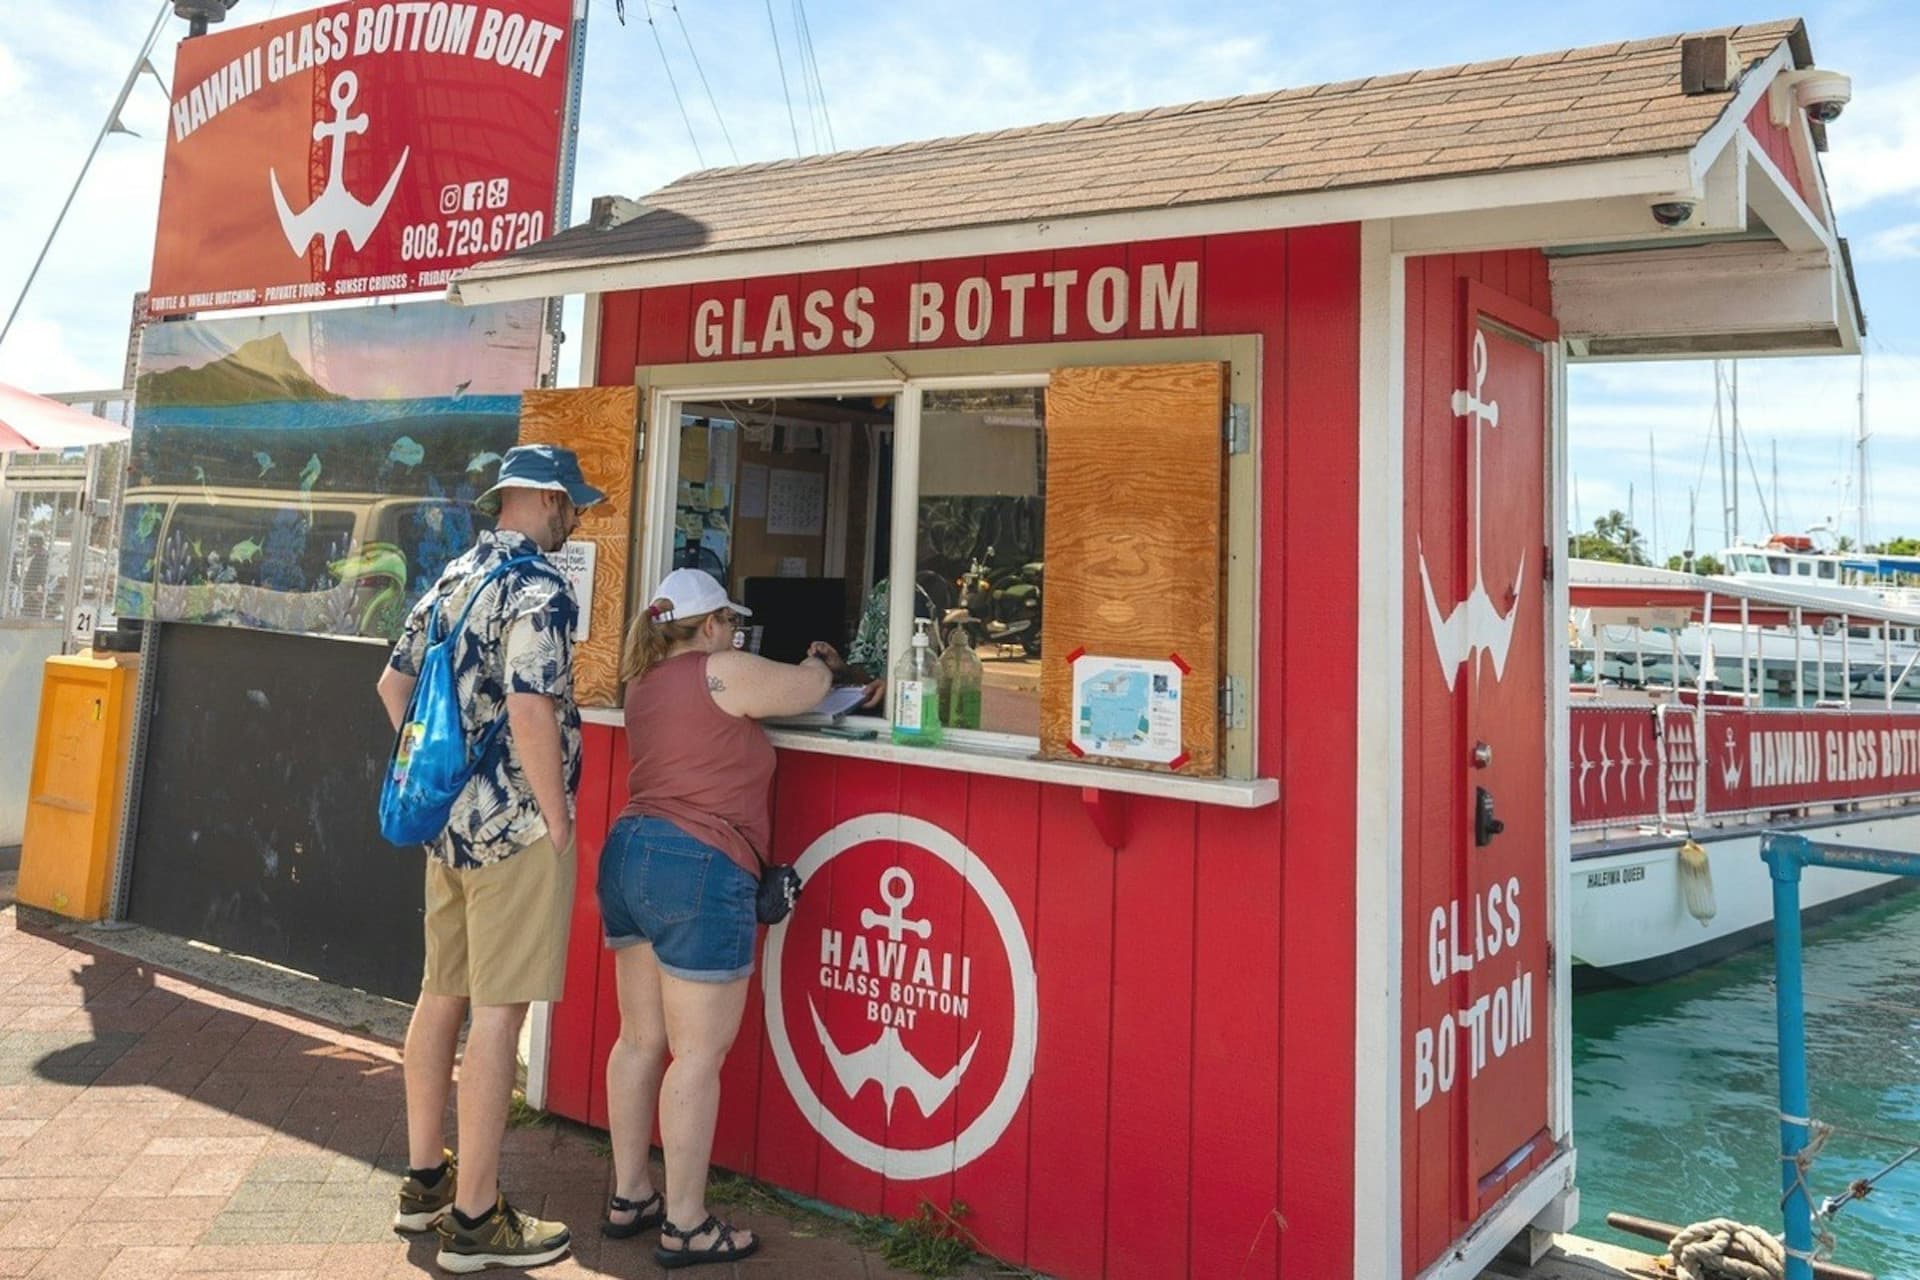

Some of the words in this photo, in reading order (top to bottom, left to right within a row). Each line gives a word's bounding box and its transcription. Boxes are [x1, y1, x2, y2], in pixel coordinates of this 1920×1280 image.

[171, 46, 262, 143] HAWAII
[268, 11, 349, 82] GLASS
[353, 1, 476, 57] BOTTOM
[474, 8, 564, 78] BOAT
[401, 210, 544, 262] 808.729.6720
[152, 295, 177, 311] TURTLE
[188, 292, 214, 307] WHALE
[215, 288, 257, 305] WATCHING
[265, 285, 298, 300] PRIVATE
[299, 281, 326, 298] TOURS
[334, 275, 368, 295] SUNSET
[369, 273, 407, 291] CRUISES
[418, 269, 454, 287] FRIDAY
[694, 285, 876, 358] GLASS
[908, 261, 1199, 344] BOTTOM
[77, 612, 91, 631] 21
[1750, 731, 1820, 787] HAWAII
[1825, 730, 1877, 782] GLASS
[1880, 729, 1920, 778] BOTT
[1623, 866, 1645, 884] QUEEN
[820, 928, 971, 995] HAWAII
[819, 967, 880, 998] GLASS
[890, 982, 968, 1019] BOTTOM
[867, 1000, 917, 1030] BOAT
[1415, 971, 1532, 1110] BOTTOM
